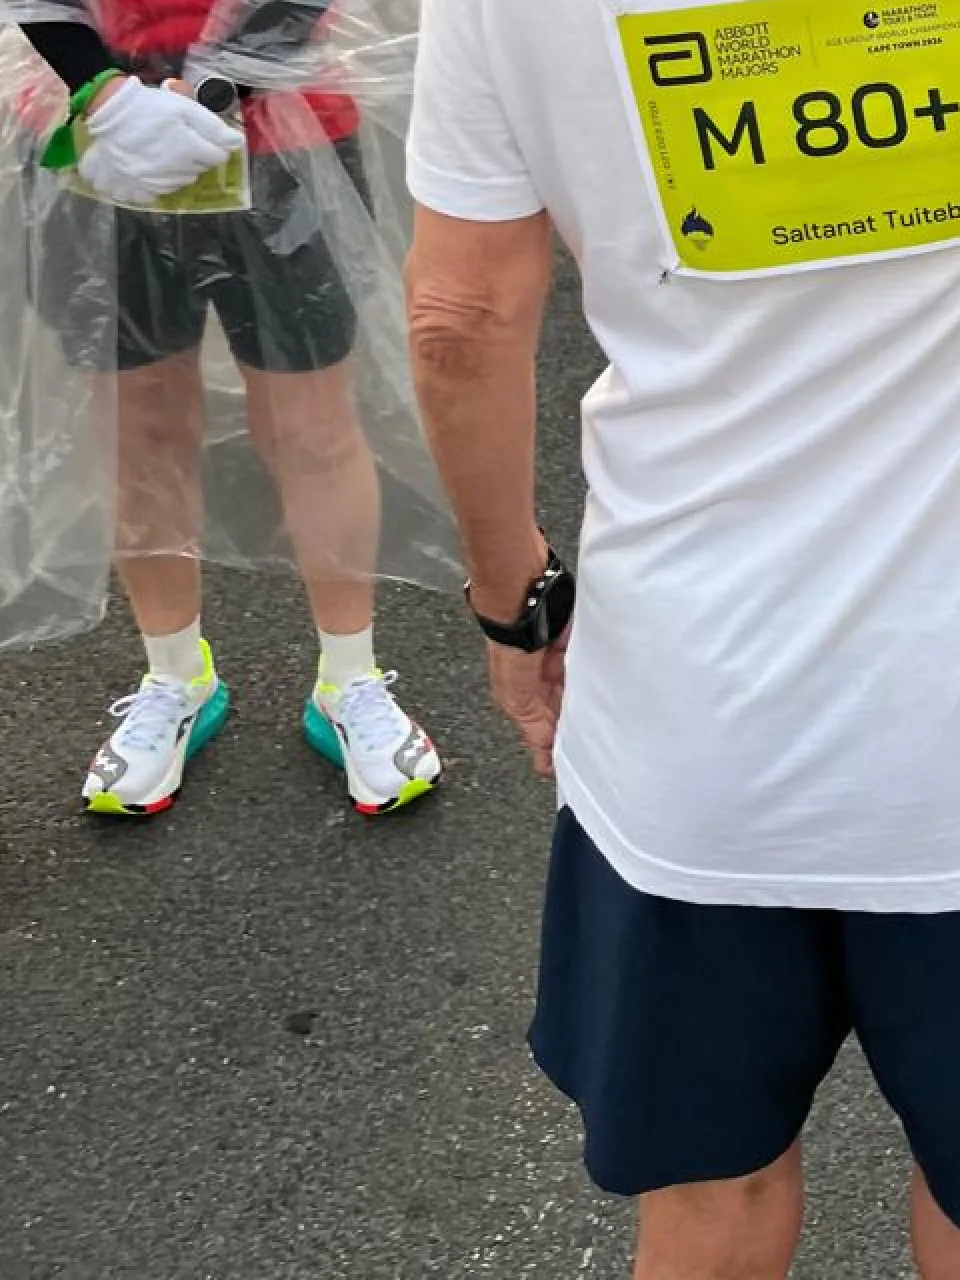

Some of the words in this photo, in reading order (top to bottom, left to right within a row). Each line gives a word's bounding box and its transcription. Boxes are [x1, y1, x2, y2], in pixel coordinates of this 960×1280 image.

[881, 3, 937, 16] MARATHON
[716, 22, 769, 40] ABBOTT
[717, 36, 770, 54] WORLD
[867, 43, 891, 54] CAPE
[891, 39, 920, 51] TOWN
[717, 45, 801, 65] MARATHON
[720, 61, 779, 80] MAJORS
[692, 100, 766, 170] M
[792, 83, 960, 157] 80+
[771, 216, 878, 245] Saltanat
